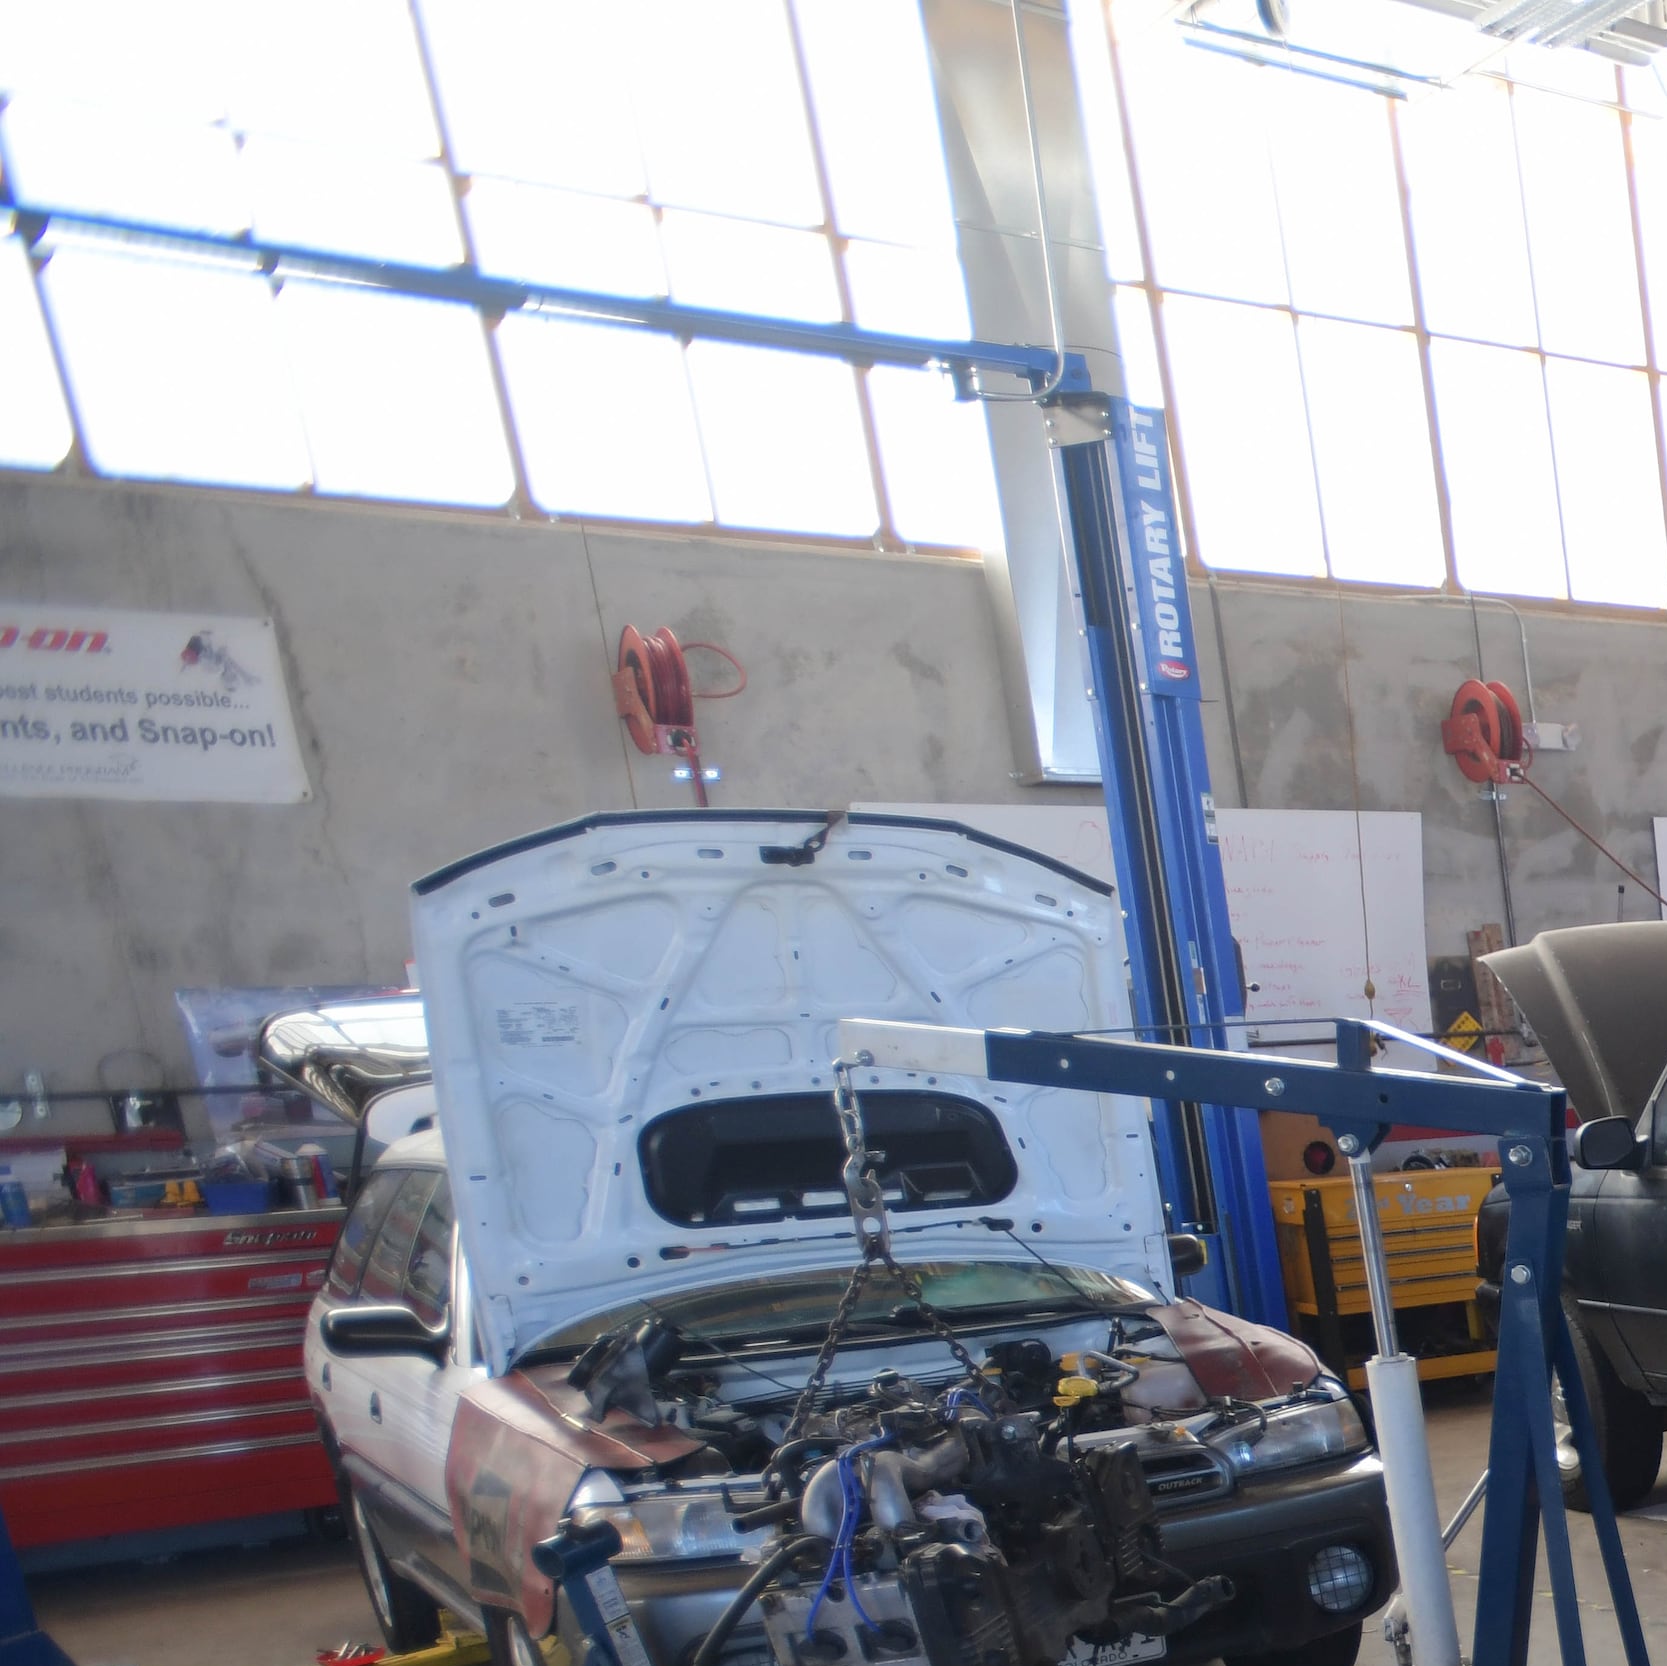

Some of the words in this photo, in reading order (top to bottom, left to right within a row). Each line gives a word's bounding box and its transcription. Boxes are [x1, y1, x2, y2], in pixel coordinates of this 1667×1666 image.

[1128, 405, 1162, 491] LIFT
[1141, 500, 1183, 658] ROTARY
[43, 684, 138, 705] students
[70, 718, 129, 743] and
[138, 719, 276, 750] Snap-on!
[1396, 1193, 1471, 1214] Year
[1158, 1477, 1204, 1491] OUTBACK
